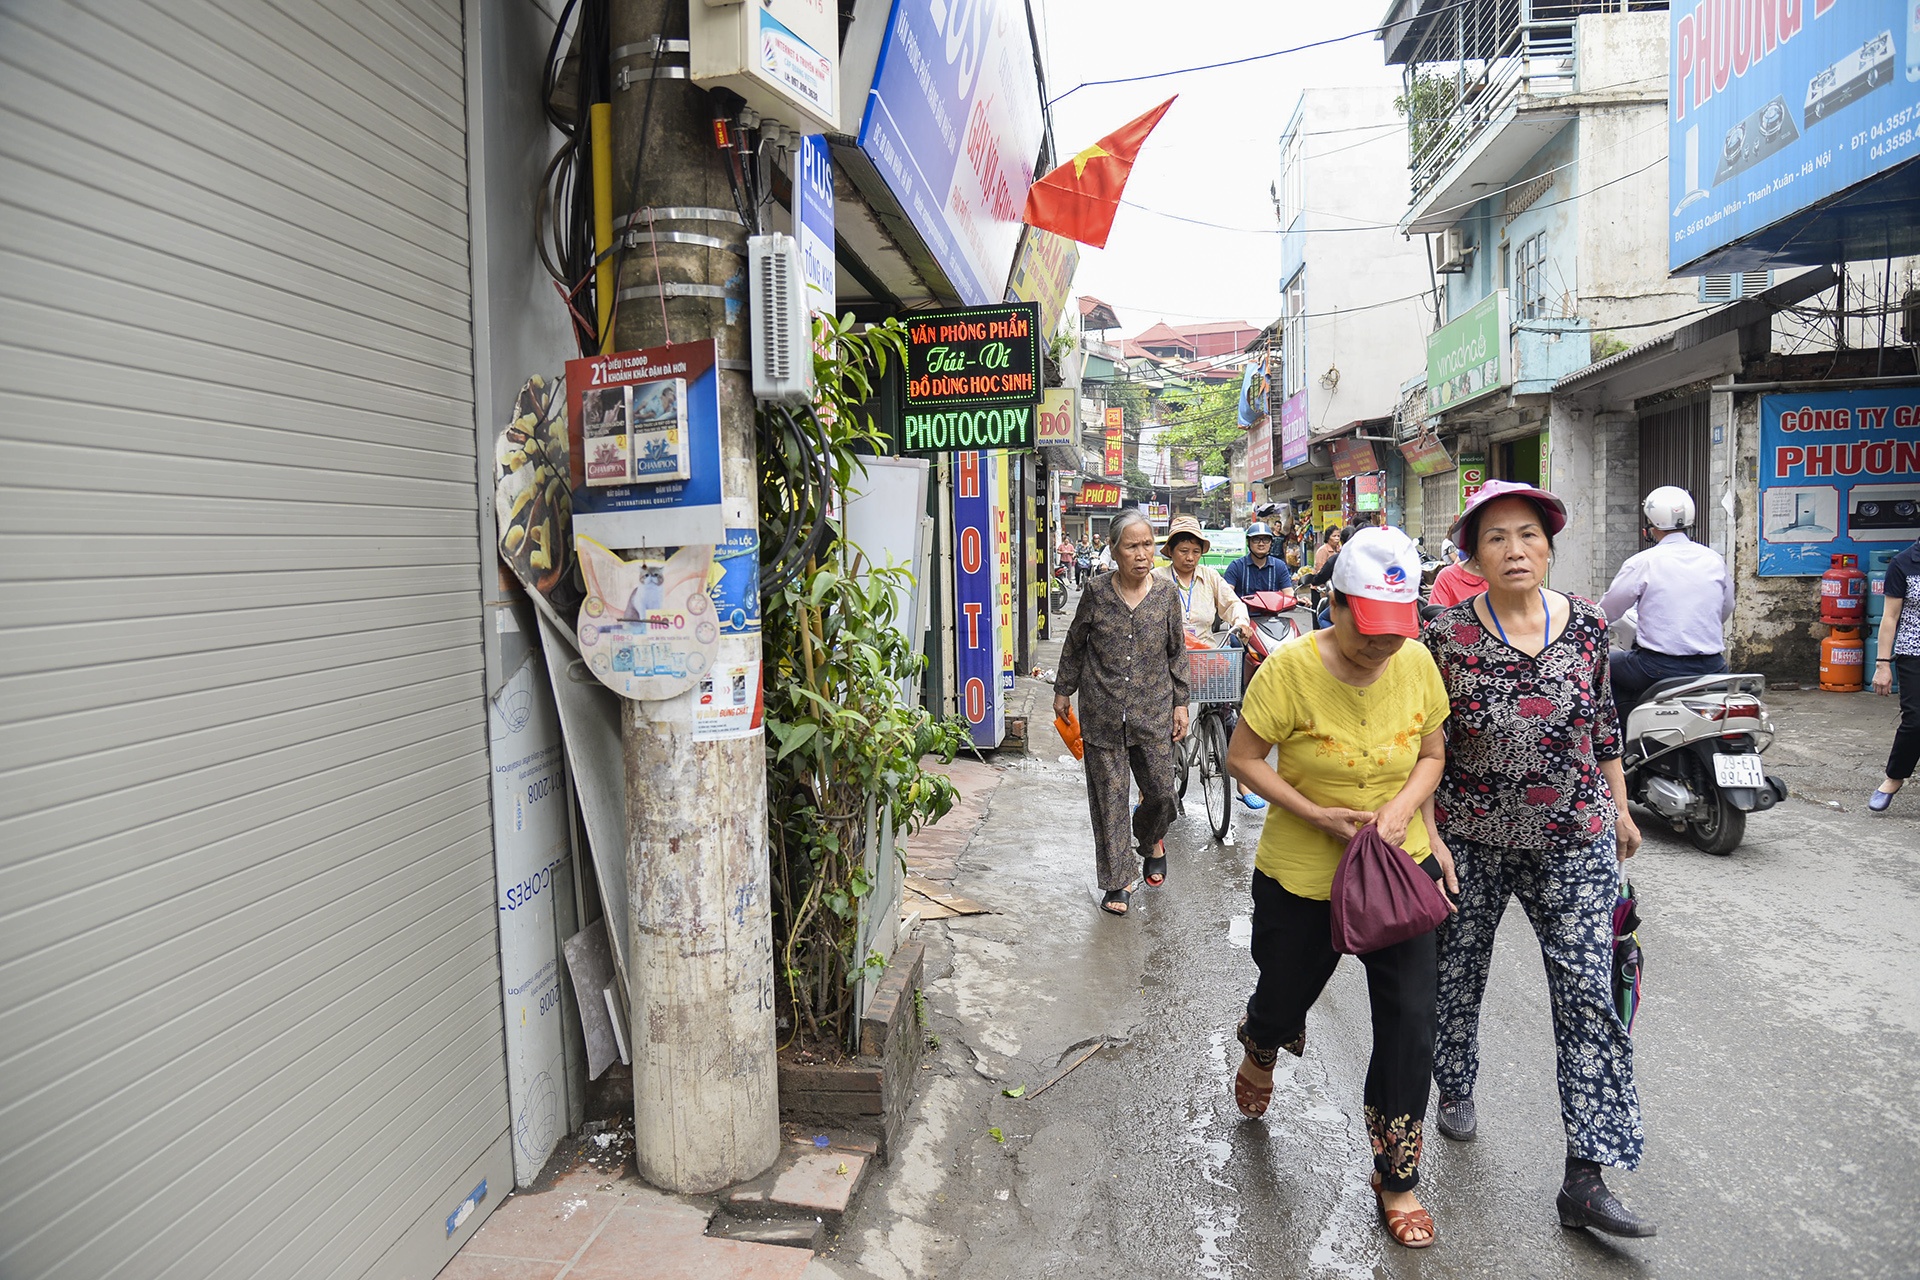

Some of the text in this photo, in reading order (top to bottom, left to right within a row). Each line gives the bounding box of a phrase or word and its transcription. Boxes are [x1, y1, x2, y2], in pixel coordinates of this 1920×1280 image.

[1851, 131, 1868, 150] ĐT:
[803, 135, 833, 209] PLUS
[1675, 229, 1686, 243] ĐC:
[1686, 219, 1695, 236] Số
[1723, 200, 1741, 218] Nhân
[1747, 184, 1771, 205] Thanh
[1772, 173, 1794, 192] Xuân
[1801, 160, 1813, 177] Hà
[1815, 149, 1832, 169] Nội
[910, 312, 1028, 345] VĂN PHÒNG PHẨM
[591, 362, 608, 385] 21
[909, 373, 1032, 398] ĐỒ DÙNG HỌC SINH
[905, 408, 1029, 449] PHOTOCOPY
[1039, 399, 1071, 436] ĐỒ
[1780, 405, 1850, 432] CÔNG
[1856, 406, 1889, 429] TY
[588, 464, 625, 475] CHAMPION
[638, 460, 676, 471] CHAMPION
[616, 497, 673, 507] INTERNATIONAL QUALITY
[1085, 484, 1105, 503] PHỞ
[1720, 772, 1761, 786] 994.11
